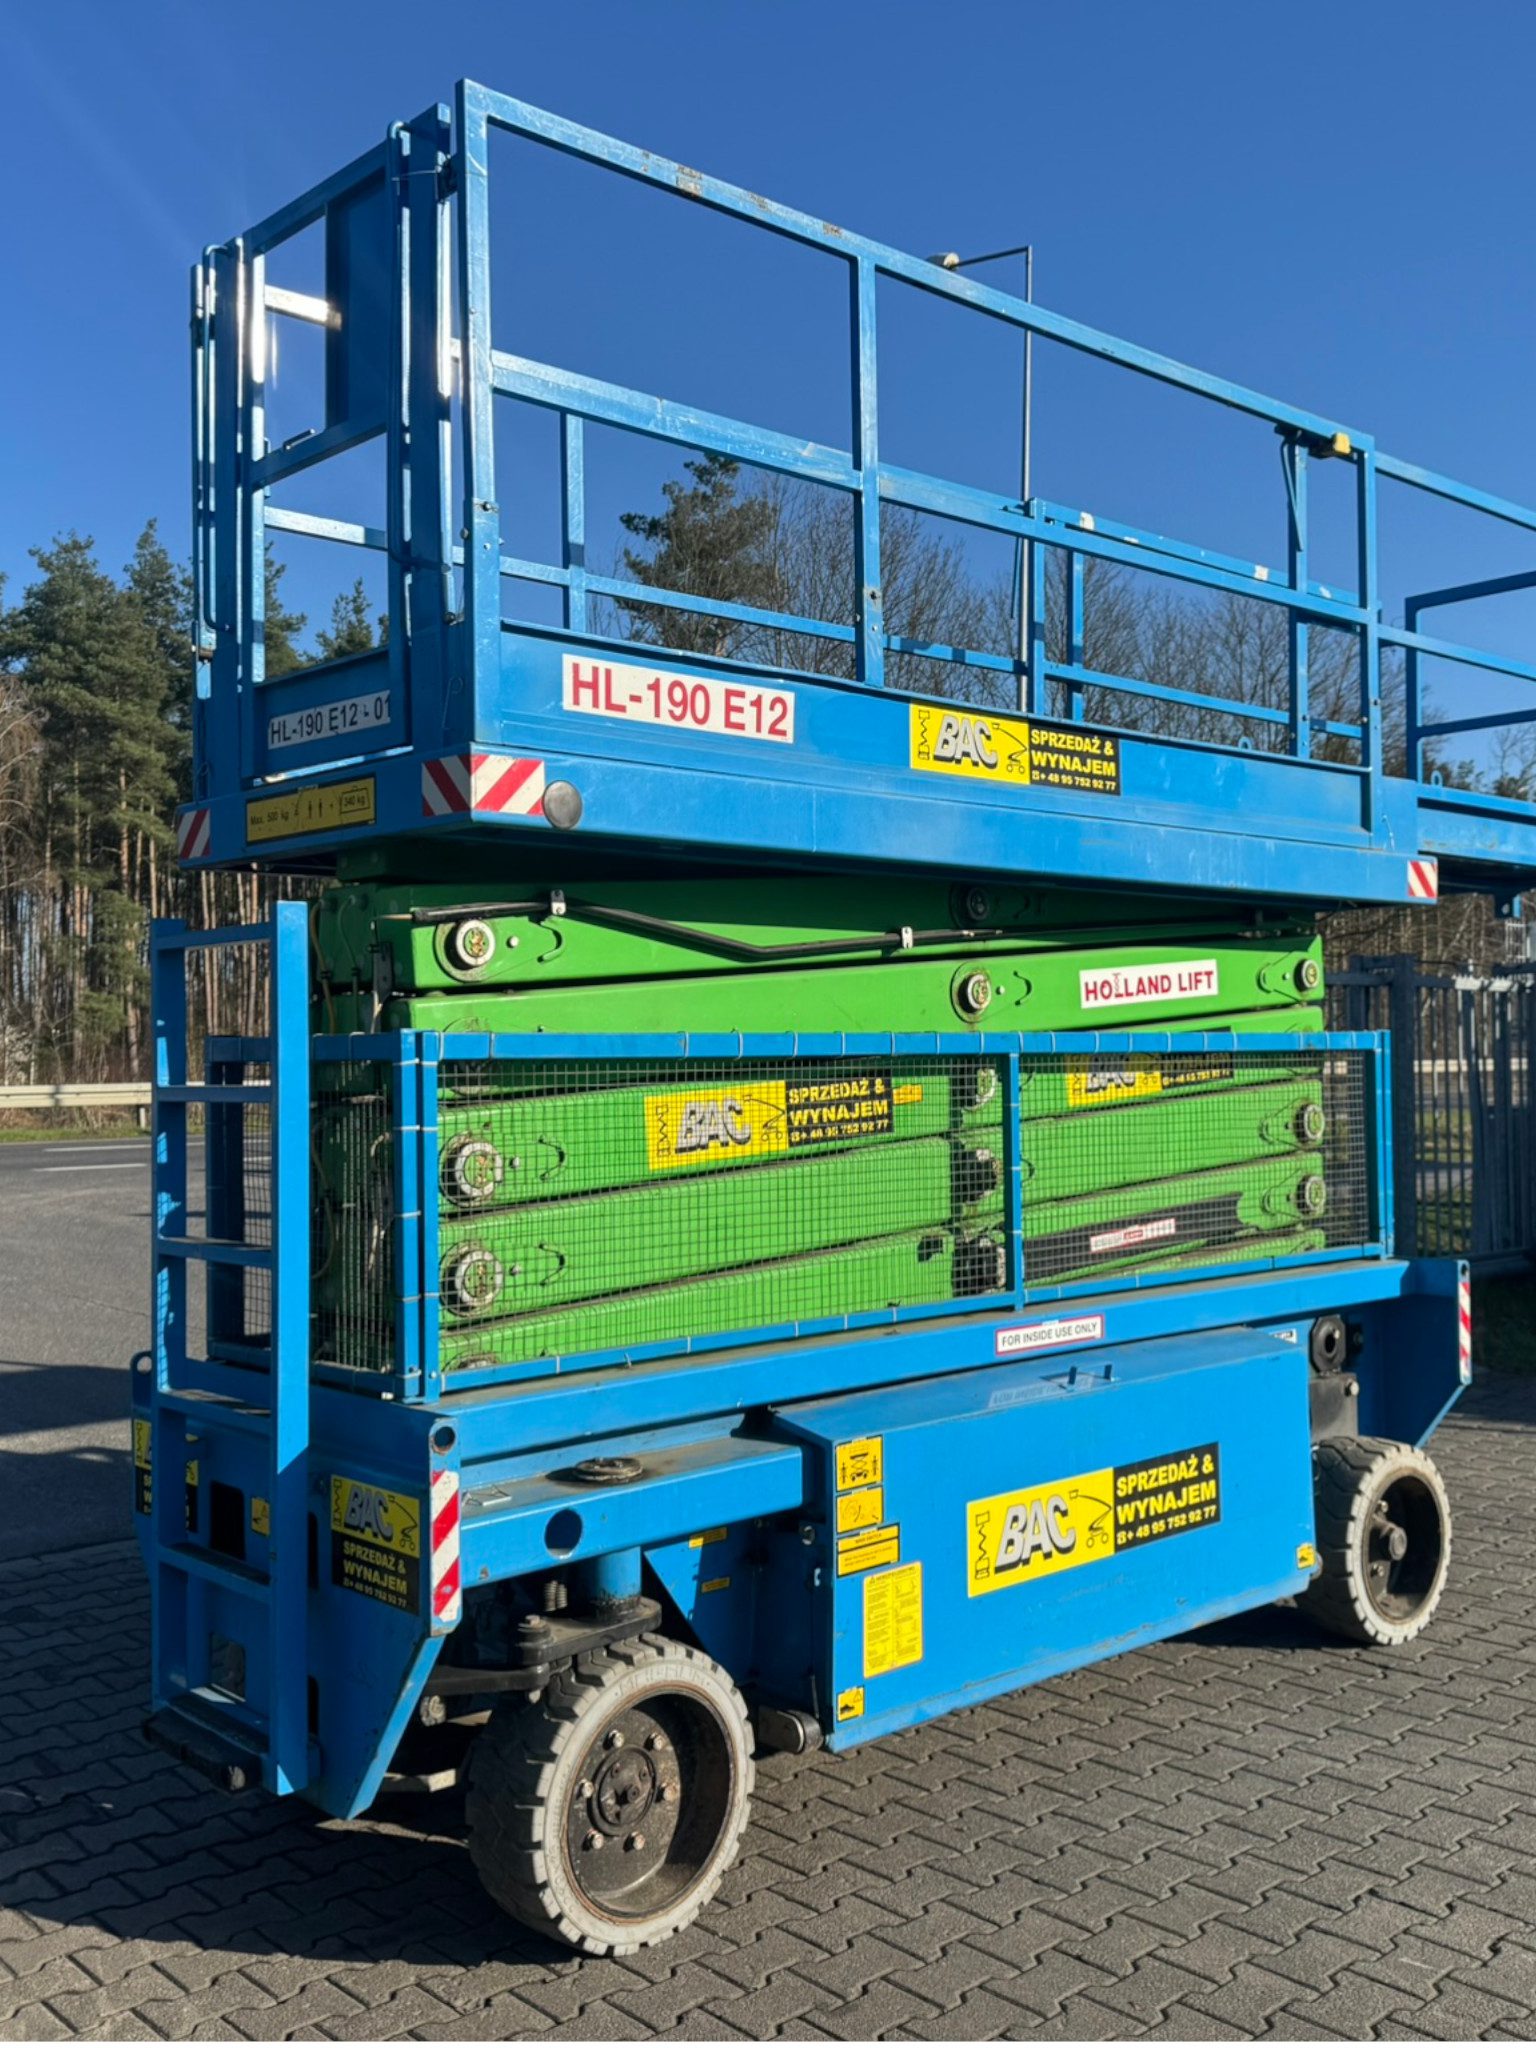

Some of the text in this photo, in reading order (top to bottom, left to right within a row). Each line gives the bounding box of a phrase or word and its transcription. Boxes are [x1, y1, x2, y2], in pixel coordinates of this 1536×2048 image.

[572, 662, 789, 738] HL-190 E12
[270, 711, 323, 745] HL-190
[329, 703, 358, 731] E12
[933, 713, 999, 770] BAC
[1030, 728, 1115, 756] SPRZEDAŻ &
[1031, 749, 1117, 778] WYNAJEM
[1104, 780, 1117, 791] 77
[1084, 970, 1214, 1002] HOLLAND LIFT
[789, 1077, 871, 1105] SPRZEDAŻ
[874, 1078, 886, 1095] &
[675, 1094, 752, 1155] BAC
[789, 1099, 889, 1127] WYNAJEM
[876, 1118, 890, 1130] 77
[1001, 1321, 1098, 1347] FOR INSIDE USE ONLY
[1116, 1453, 1215, 1498] SPRZEDAŻ &
[343, 1483, 394, 1543] BAC
[1116, 1479, 1217, 1525] WYNAJEM
[993, 1493, 1077, 1575] BAC
[1135, 1523, 1150, 1539] 48
[1151, 1519, 1166, 1534] 95
[1166, 1513, 1188, 1530] 752
[1187, 1509, 1203, 1524] 92
[1203, 1504, 1217, 1519] 77
[343, 1539, 407, 1575] SPRZEDAŻ &
[342, 1558, 408, 1596] WYNAJEM
